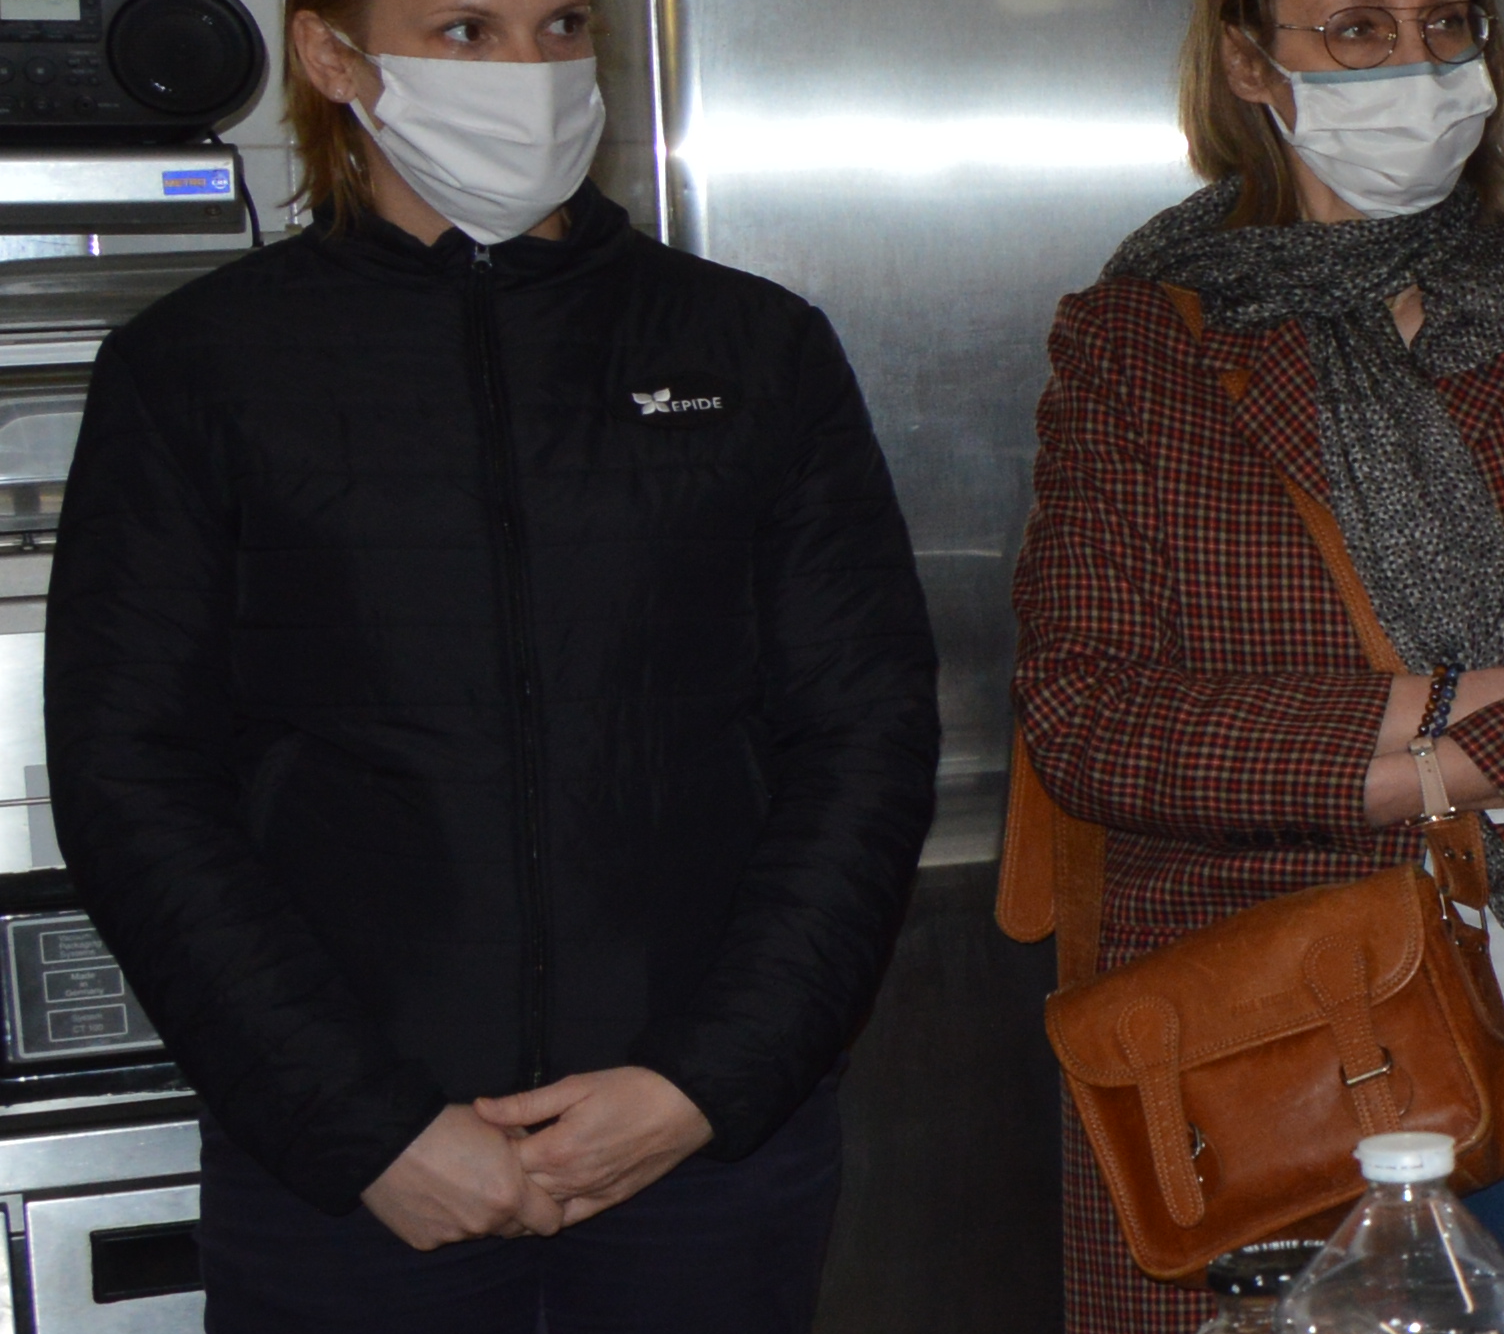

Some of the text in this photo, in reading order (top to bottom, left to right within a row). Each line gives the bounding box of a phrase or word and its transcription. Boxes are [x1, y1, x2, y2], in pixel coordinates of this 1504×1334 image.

[671, 396, 723, 412] EPIDE
[71, 972, 95, 980] Made
[65, 988, 104, 998] Germany
